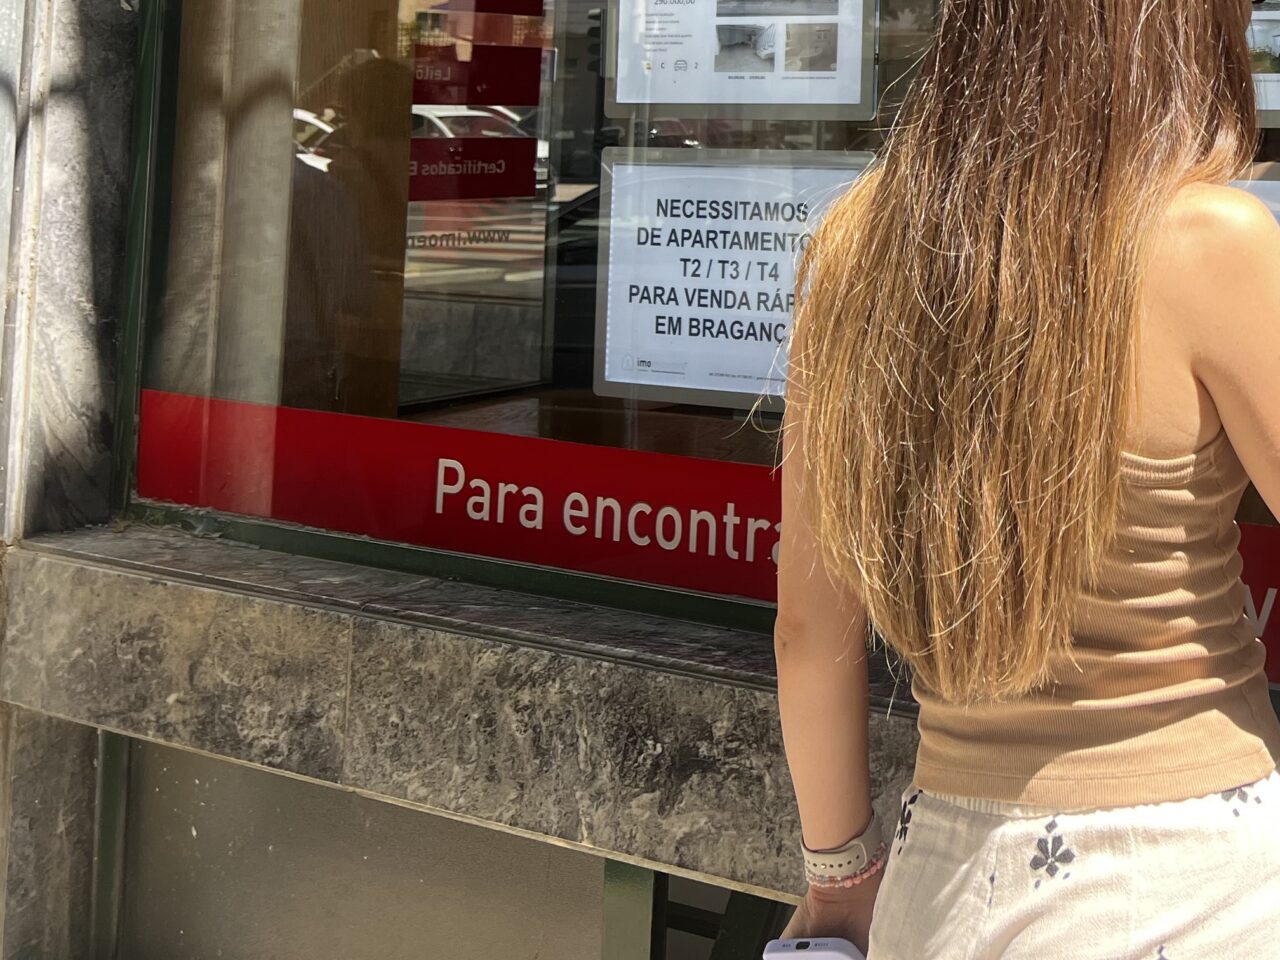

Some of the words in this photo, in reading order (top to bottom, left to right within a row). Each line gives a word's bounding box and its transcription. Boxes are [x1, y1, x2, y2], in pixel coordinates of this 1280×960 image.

[656, 199, 809, 223] NECESSITAMOS
[637, 227, 662, 246] DE
[680, 258, 701, 278] T2
[707, 259, 713, 279] /
[718, 260, 740, 280] T3
[745, 262, 751, 281] /
[757, 261, 779, 282] T4
[628, 284, 679, 306] PARA
[684, 288, 751, 311] VENDA
[655, 316, 682, 336] EM
[435, 458, 545, 530] Para
[563, 491, 782, 566] encontr
